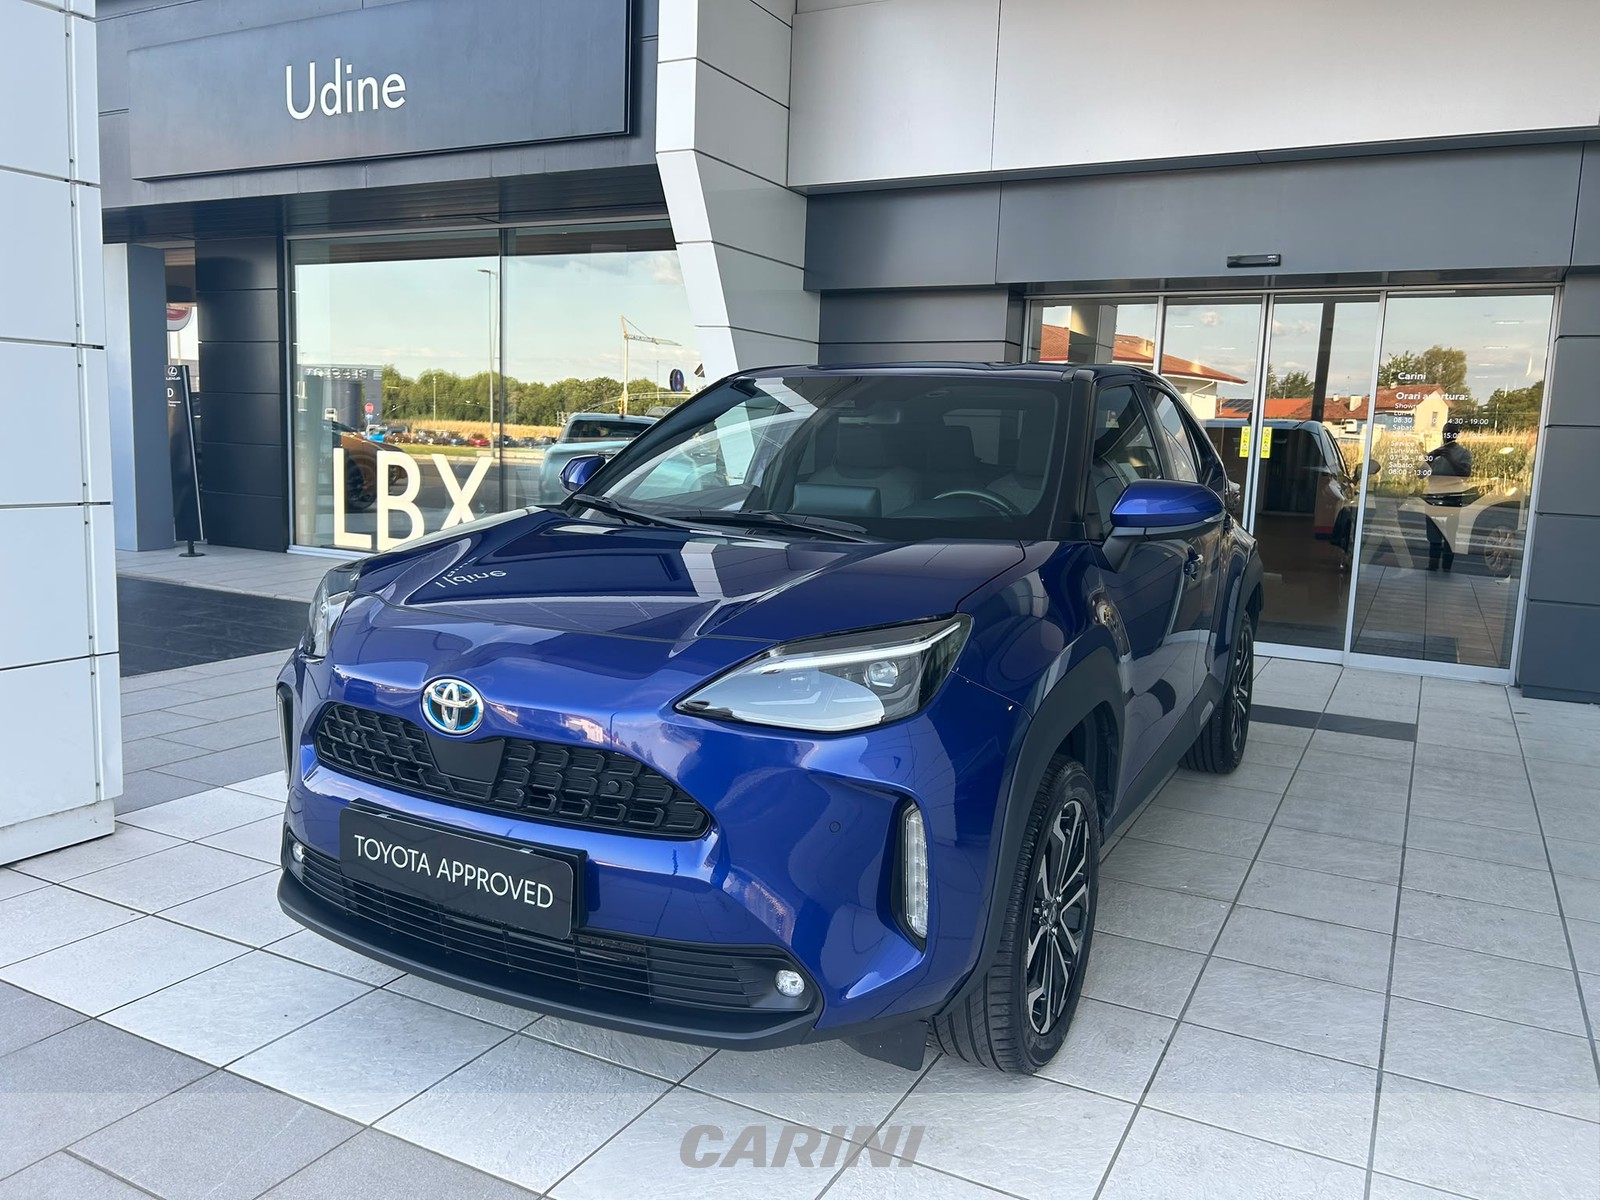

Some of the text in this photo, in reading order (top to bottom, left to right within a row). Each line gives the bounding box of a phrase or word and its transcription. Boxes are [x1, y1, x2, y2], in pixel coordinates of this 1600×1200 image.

[286, 57, 407, 120] Udine
[1395, 391, 1469, 402] Orari artura:
[1398, 372, 1427, 381] Carini
[333, 447, 494, 551] LBX
[354, 834, 554, 909] TOYOTA APPROVED
